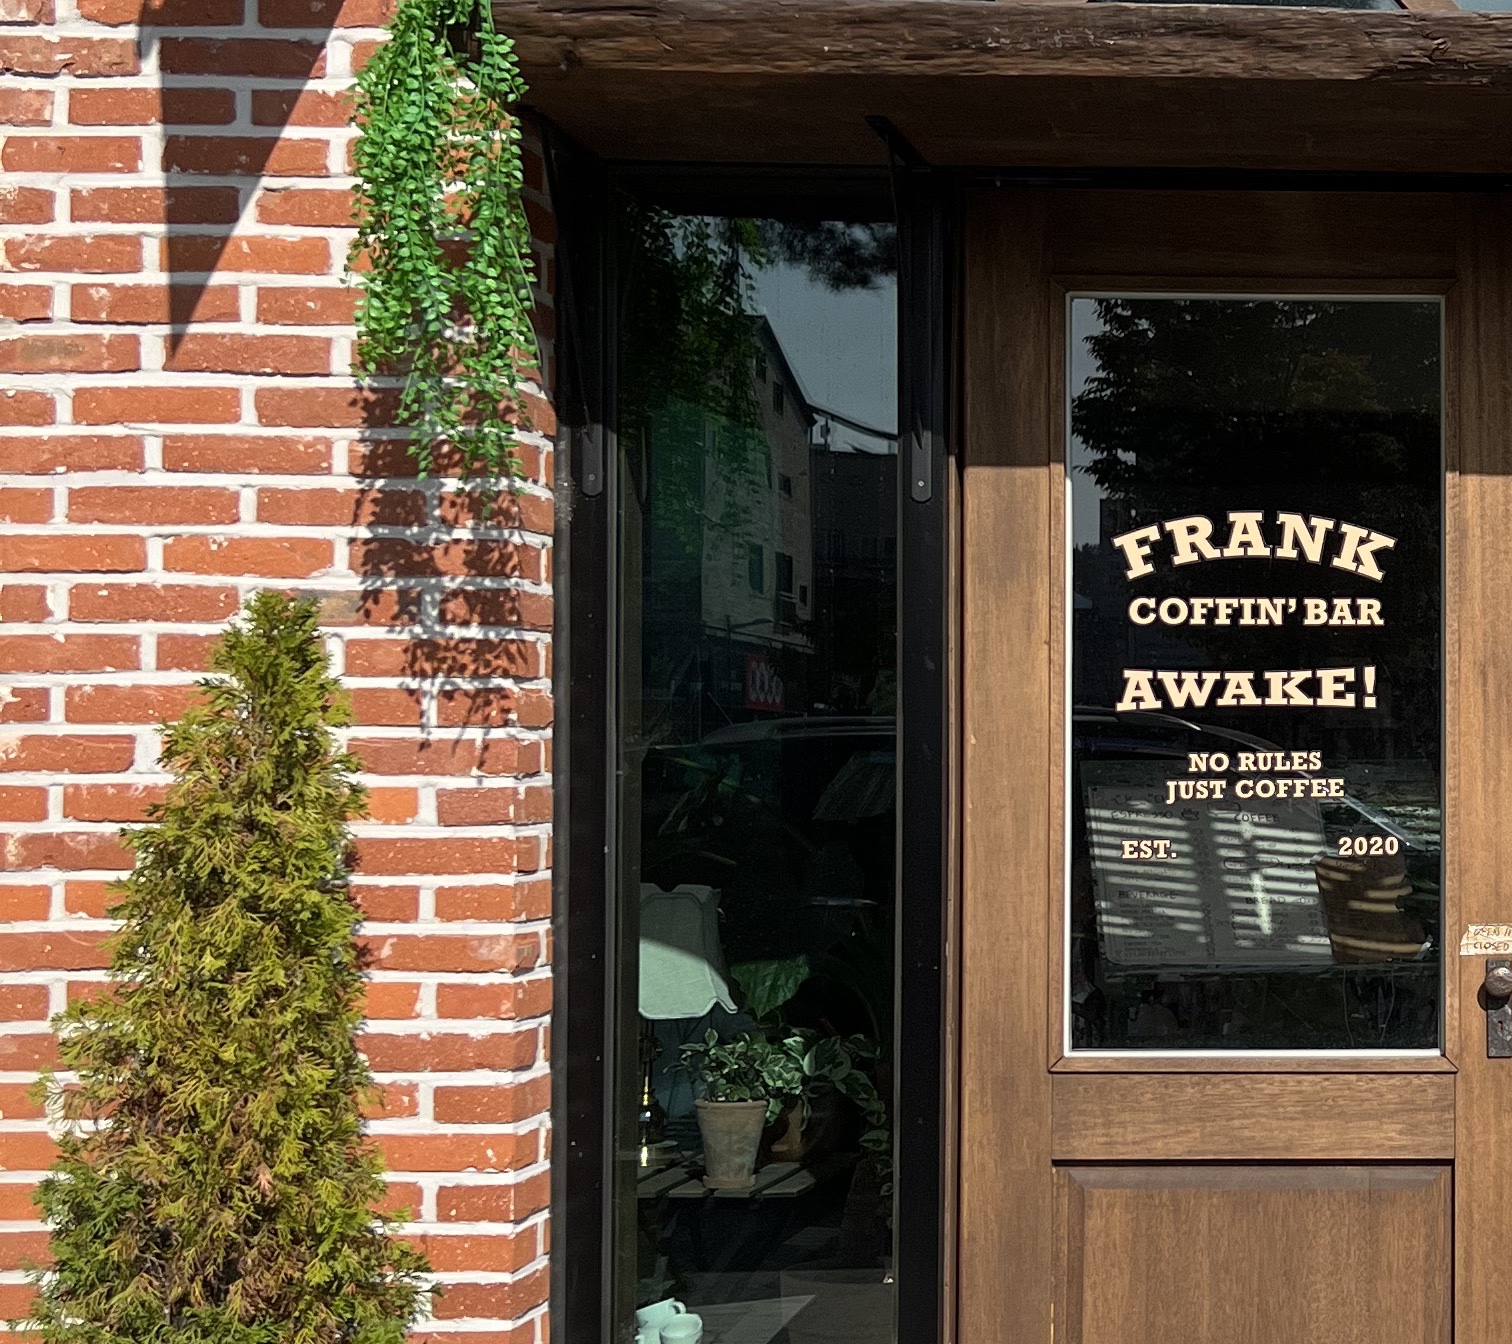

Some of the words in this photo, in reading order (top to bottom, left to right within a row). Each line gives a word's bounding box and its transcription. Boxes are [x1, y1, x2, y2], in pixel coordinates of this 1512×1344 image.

[1112, 510, 1398, 582] FRANK
[1128, 597, 1297, 626] COFFIN'
[1303, 598, 1385, 626] BAR
[1116, 665, 1377, 712] AWAKE!
[1188, 752, 1230, 772] NO
[1237, 751, 1322, 772] RULES
[1165, 779, 1227, 804] JUST
[1234, 778, 1345, 799] COFFEE
[1121, 839, 1178, 860] EST.
[1338, 836, 1399, 856] 2020
